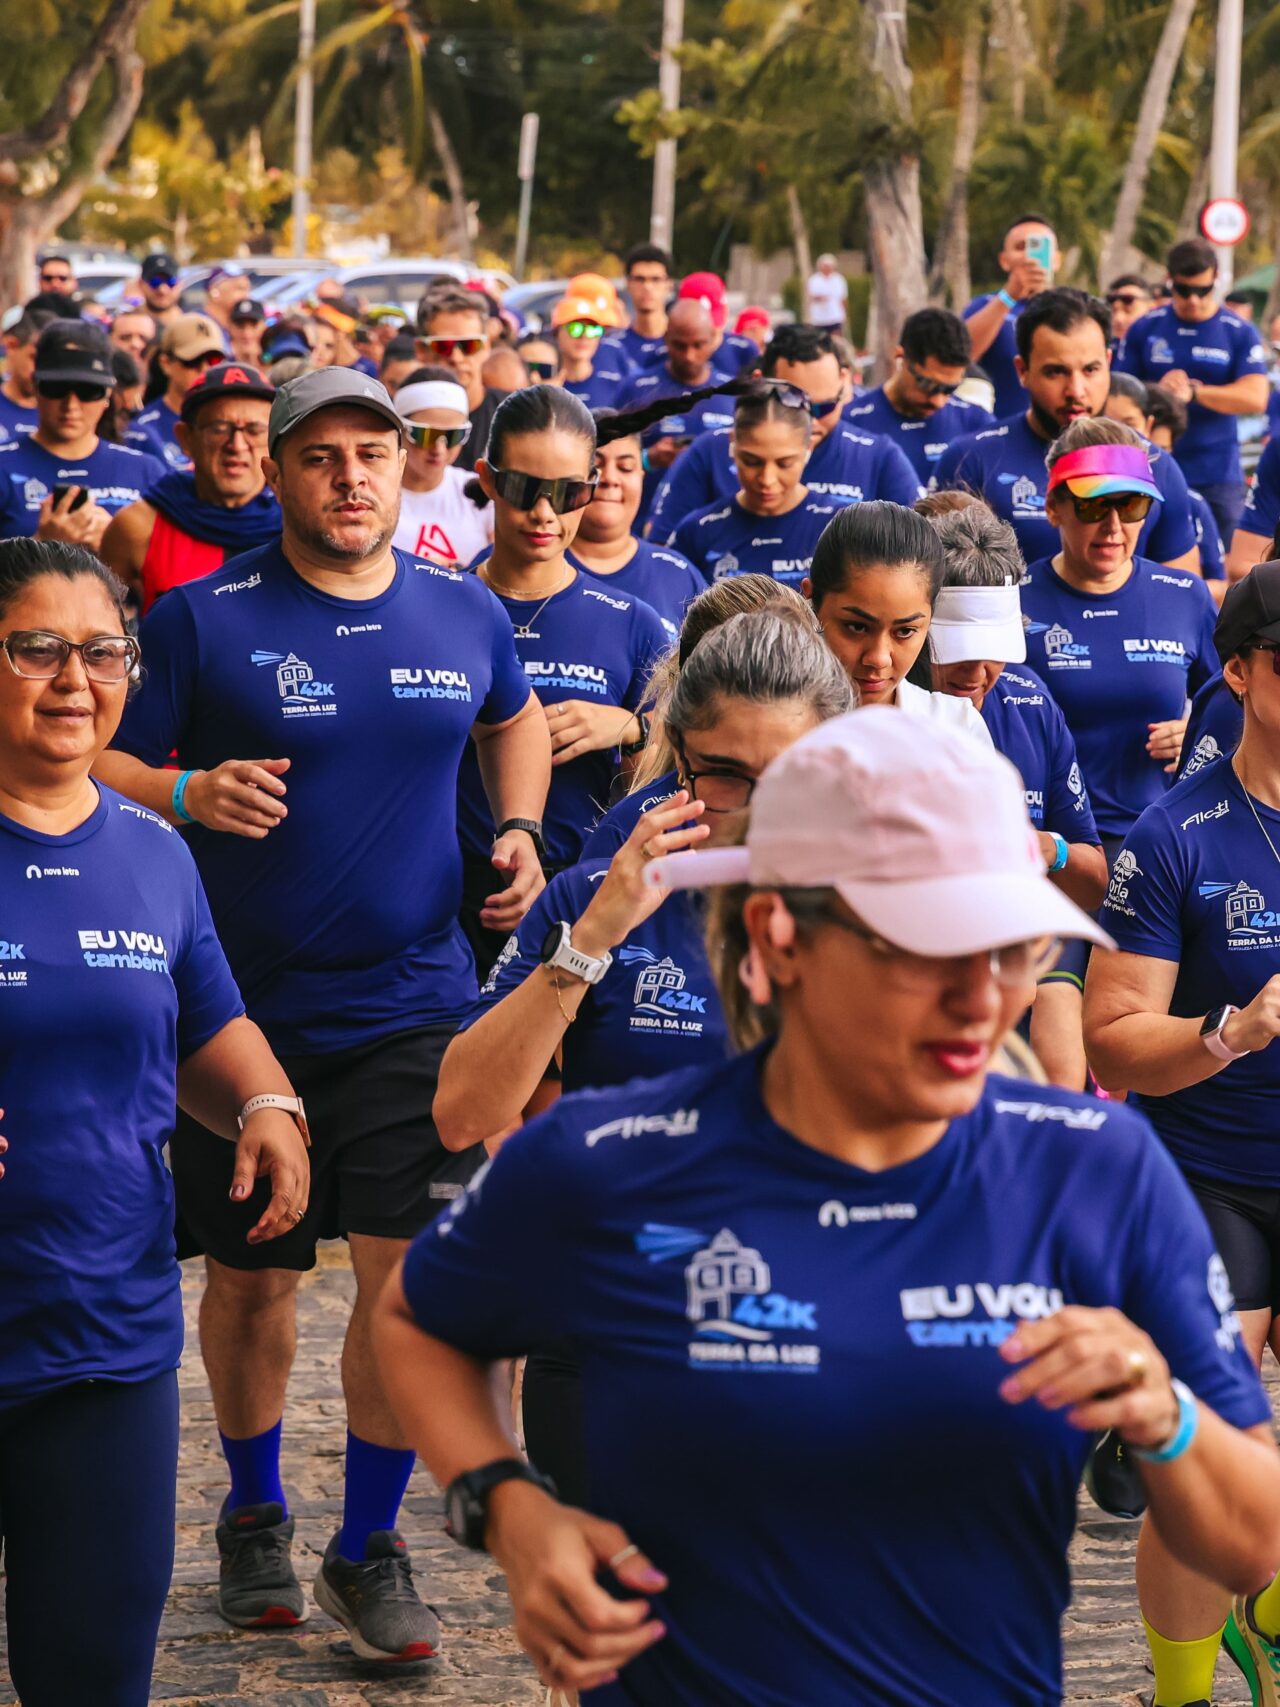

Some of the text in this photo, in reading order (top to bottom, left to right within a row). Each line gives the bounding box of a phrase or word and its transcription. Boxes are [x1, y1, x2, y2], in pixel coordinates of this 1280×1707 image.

[1123, 639, 1148, 652] EU
[390, 669, 471, 692] EU VOU,
[525, 661, 608, 685] EU VOU,
[300, 681, 336, 697] 42K
[281, 705, 308, 715] TERRA
[309, 704, 321, 713] DA
[322, 703, 338, 712] LUZ
[44, 865, 80, 877] nova letra
[0, 940, 26, 960] 2K
[78, 930, 168, 962] EU VOU,
[1227, 938, 1258, 948] TERRA
[1259, 936, 1273, 945] DA
[8, 971, 28, 981] LUZ
[658, 989, 707, 1014] 42K
[629, 1017, 703, 1032] TERRA DA LUZ
[901, 1284, 974, 1320] EU
[734, 1293, 818, 1331] 42K
